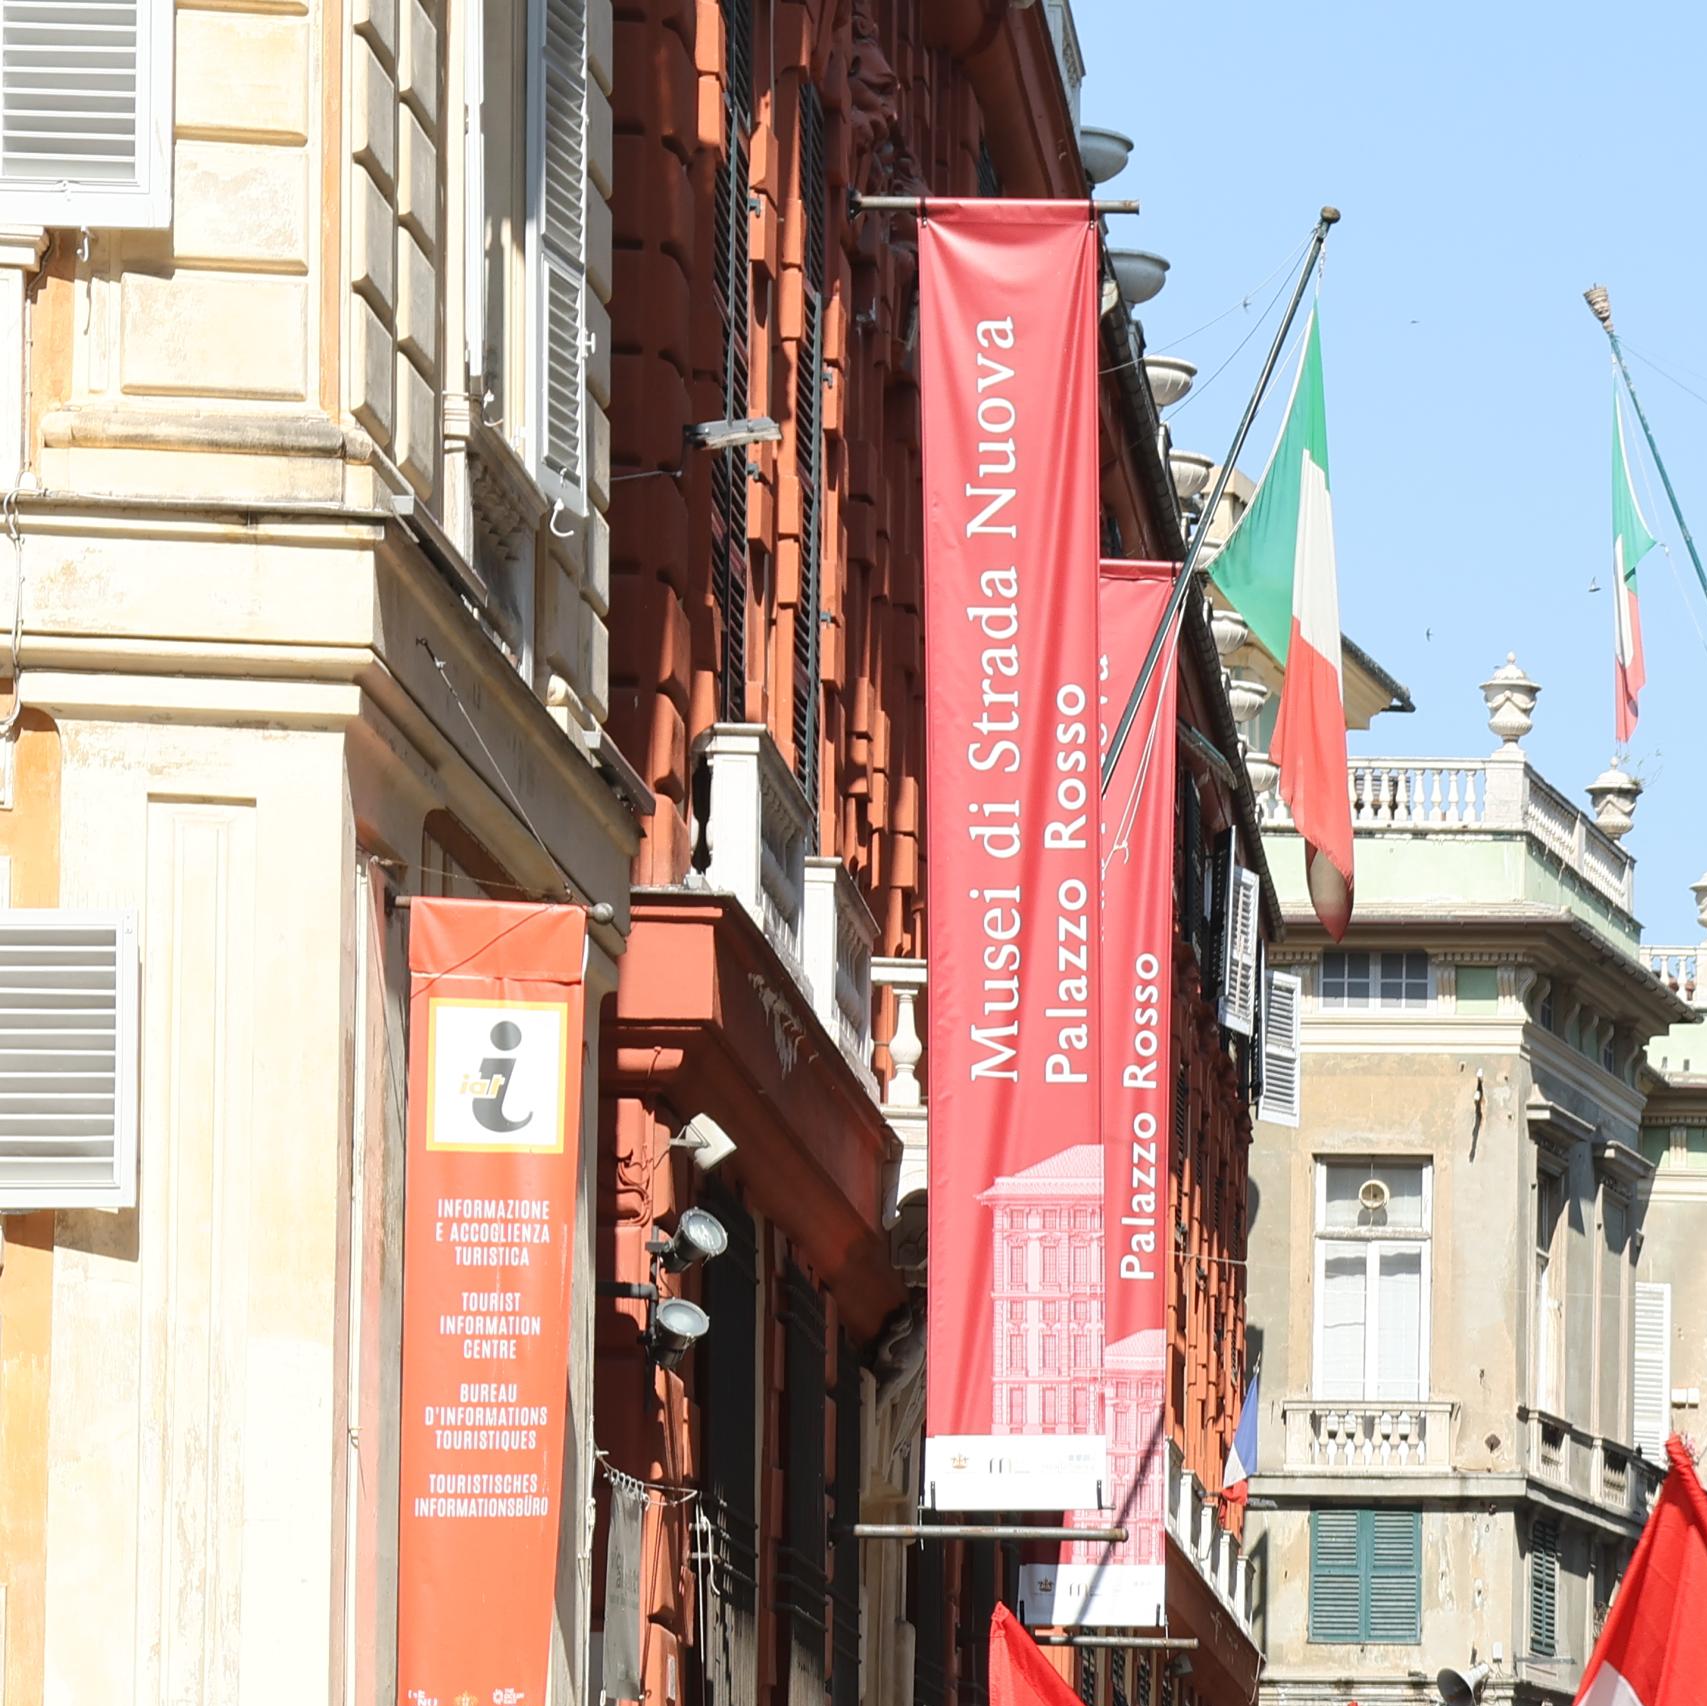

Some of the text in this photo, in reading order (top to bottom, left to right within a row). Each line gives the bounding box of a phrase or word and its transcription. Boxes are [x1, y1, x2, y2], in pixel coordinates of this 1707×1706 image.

[965, 315, 1022, 1083] Musei di Strada Nuova
[1043, 683, 1088, 1084] Palazzo Rosso
[1119, 952, 1160, 1280] Palazzo Rosso
[437, 1198, 550, 1220] INFORMAZIONE
[435, 1222, 550, 1243] E ACCOGLIENZA
[454, 1246, 529, 1266] TURISTICA
[462, 1292, 521, 1311] TOURIST
[440, 1315, 541, 1335] INFORMATION
[463, 1339, 517, 1359] CENTRE
[459, 1384, 518, 1403] BUREAU
[424, 1406, 548, 1426] D'INFORMATIONS
[434, 1430, 537, 1451] TOURISTIQUES
[429, 1474, 538, 1493] TOURISTISCHES
[415, 1494, 549, 1517] INFORMATIONSBÜRO
